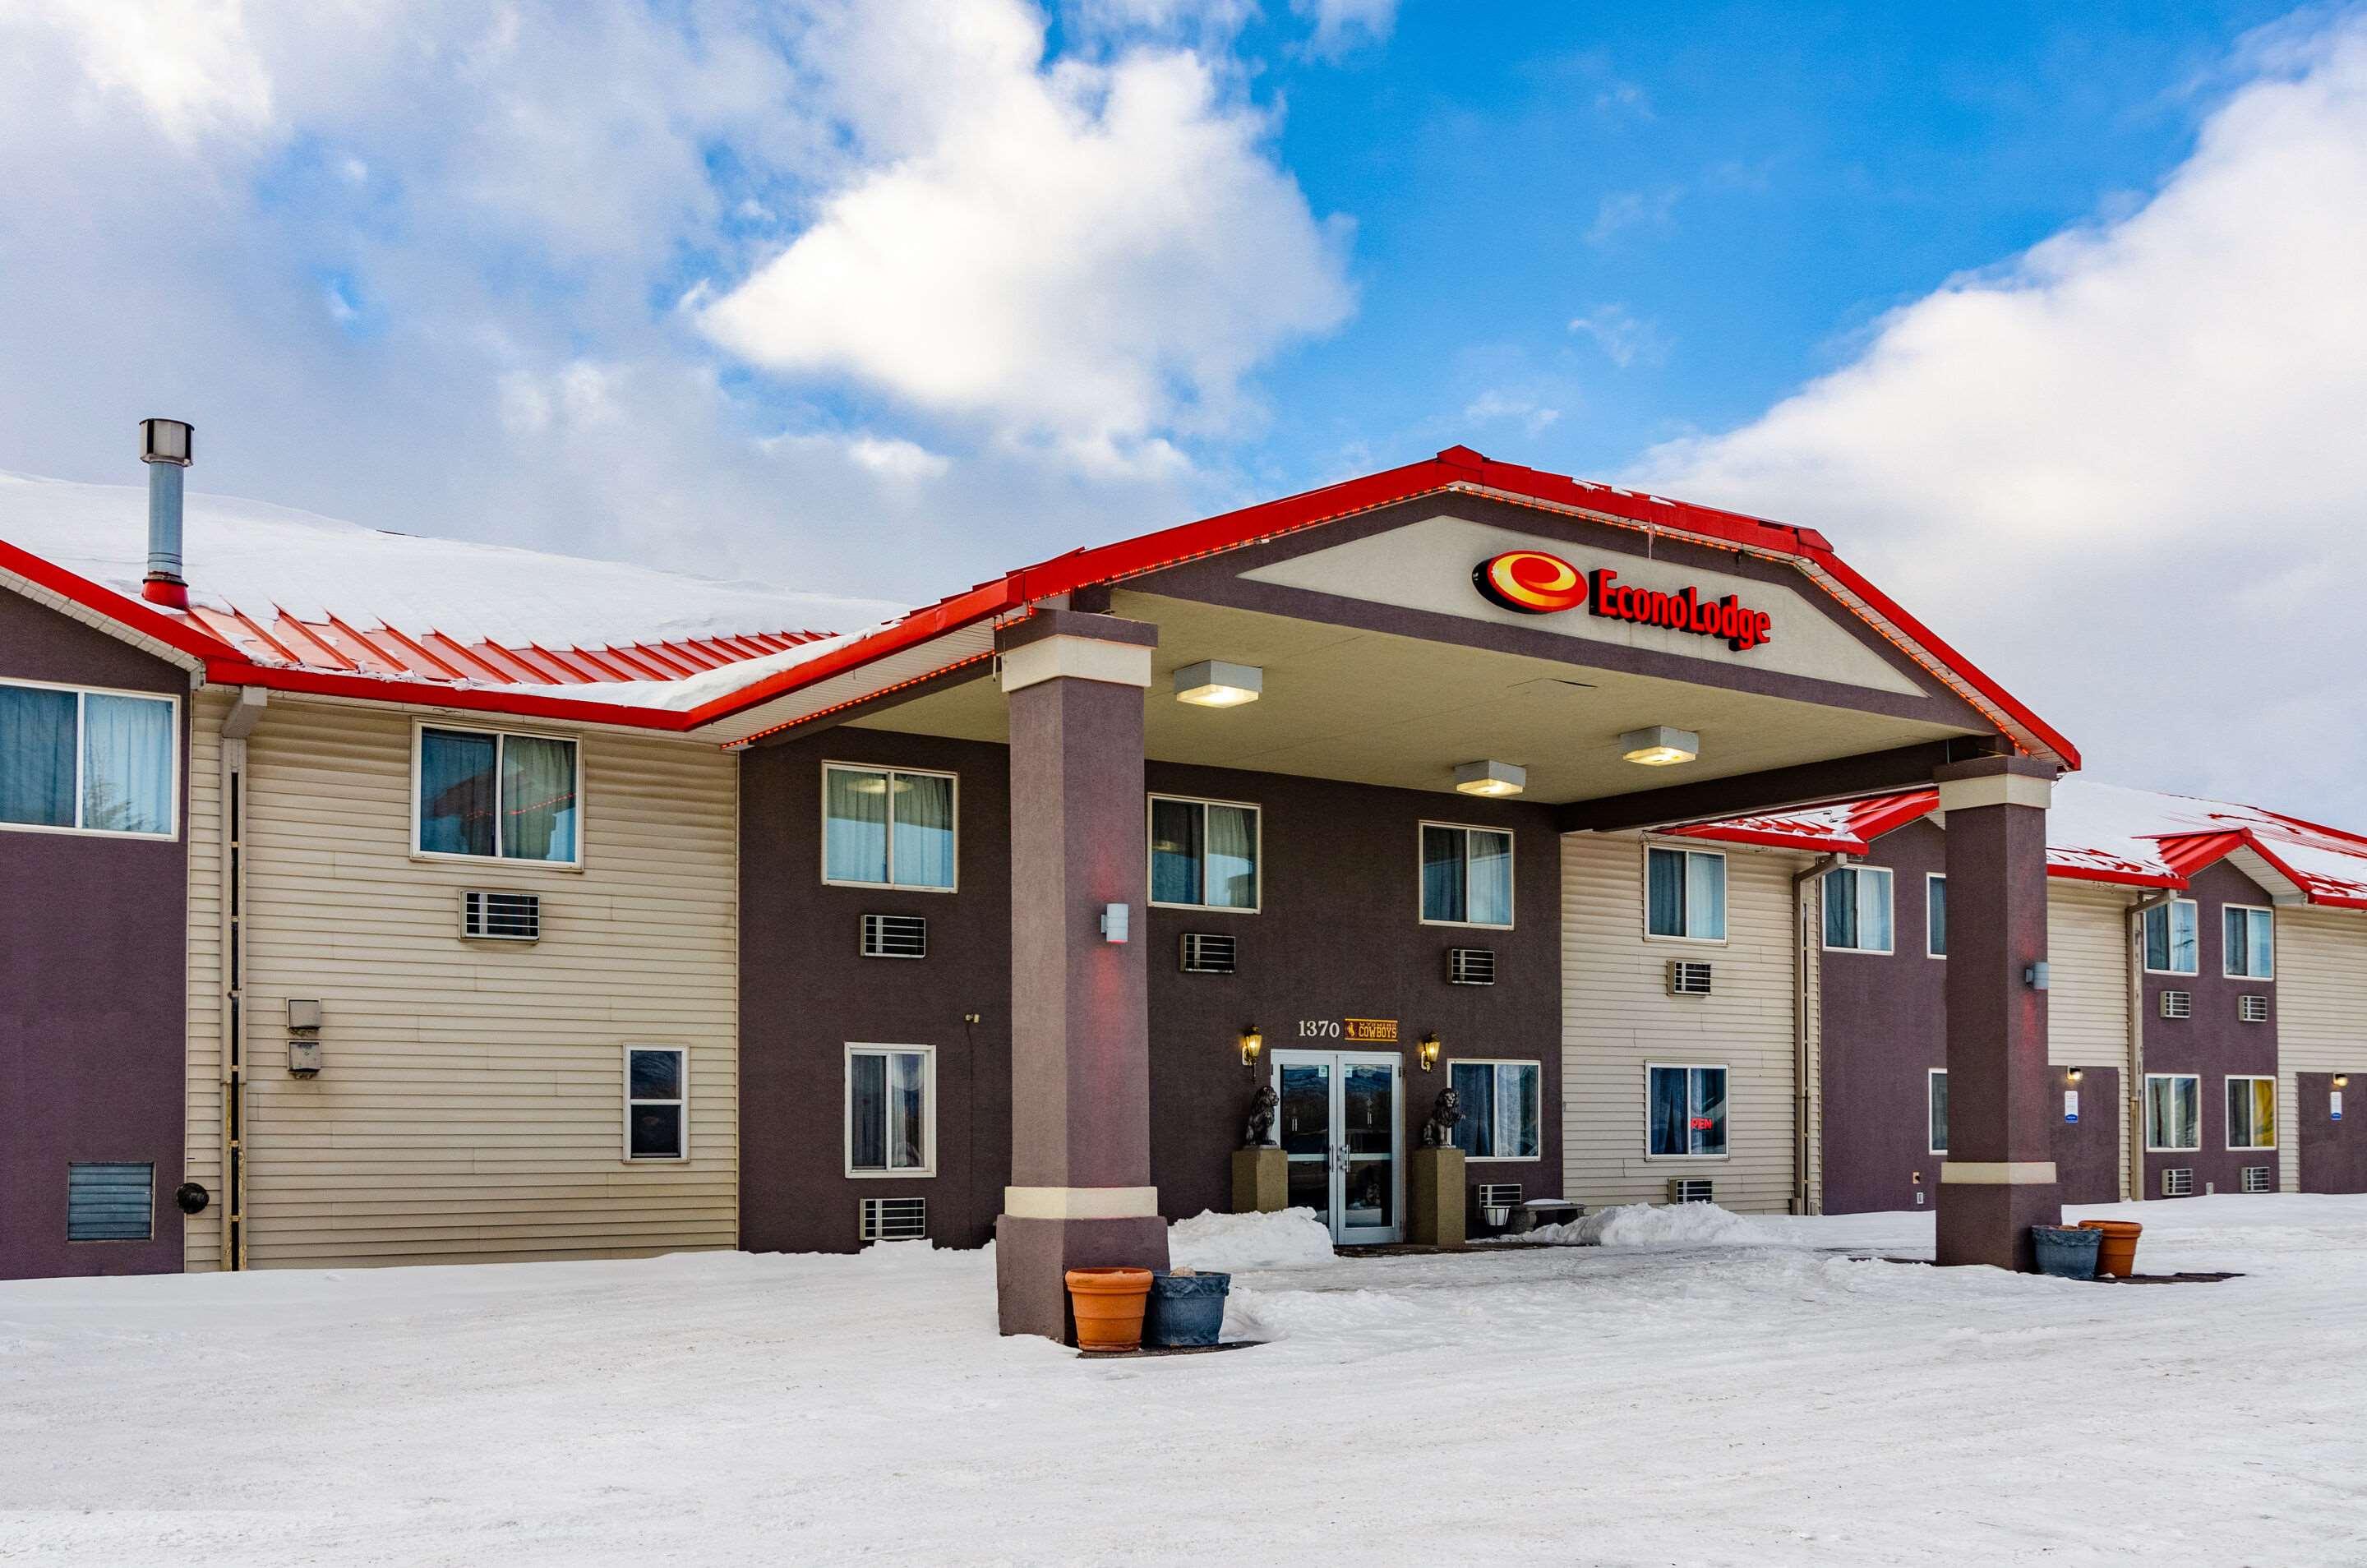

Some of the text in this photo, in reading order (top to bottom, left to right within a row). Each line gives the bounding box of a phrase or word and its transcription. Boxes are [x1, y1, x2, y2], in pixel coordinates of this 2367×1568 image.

[1598, 568, 1771, 651] EconoLodge
[1299, 1020, 1340, 1038] 1370
[1359, 1026, 1397, 1039] COWBOYS
[1691, 1117, 1713, 1131] PEN
